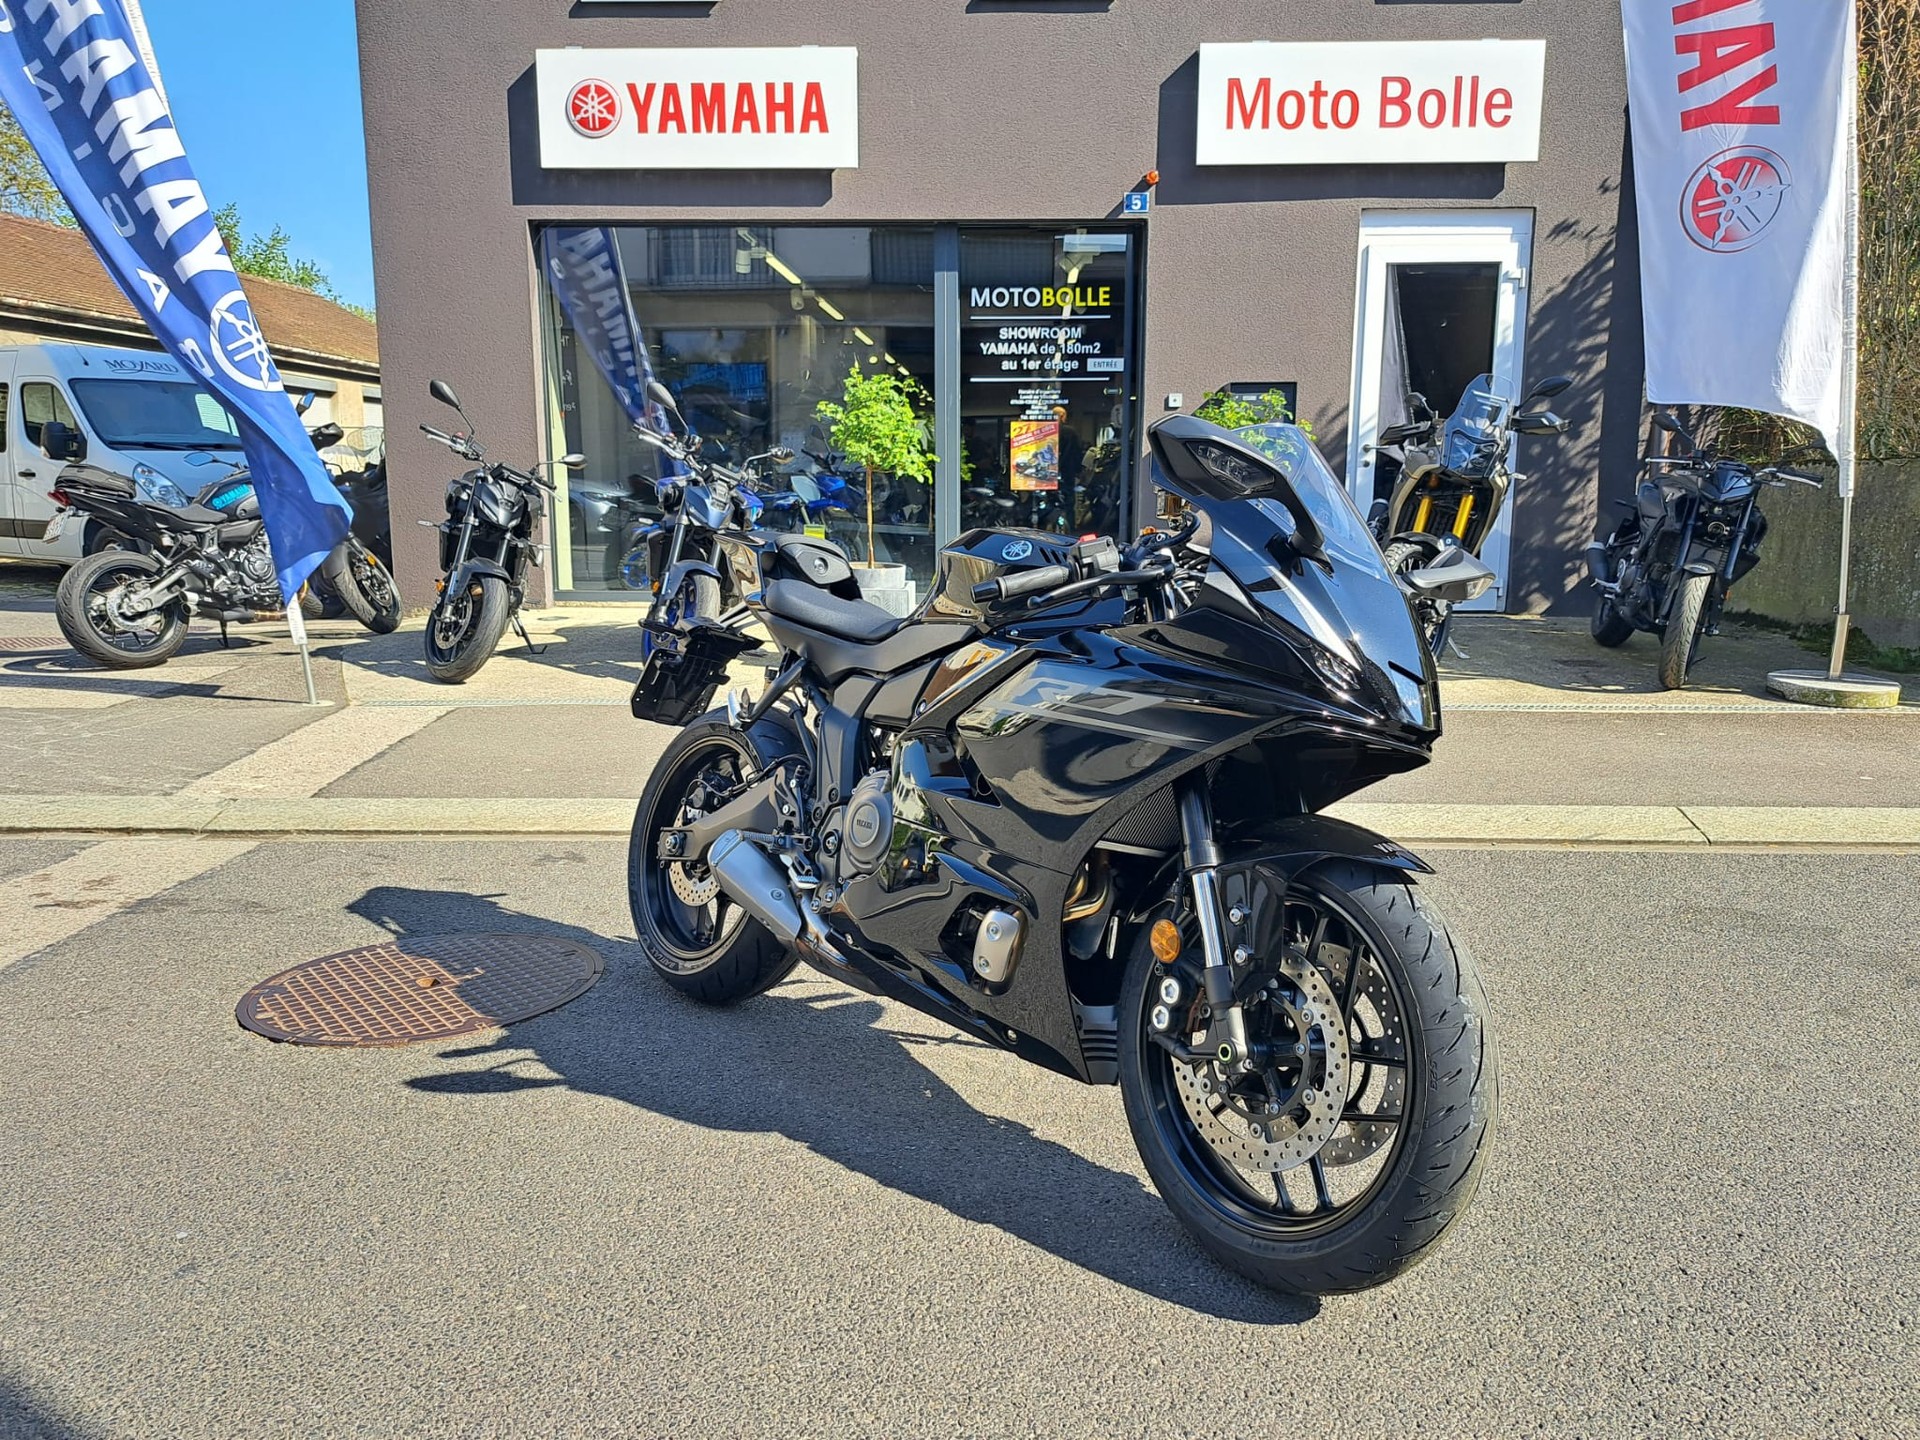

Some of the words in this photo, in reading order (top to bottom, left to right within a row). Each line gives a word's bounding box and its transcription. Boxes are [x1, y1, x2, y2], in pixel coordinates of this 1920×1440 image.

[626, 82, 829, 133] YAMAHA
[1225, 77, 1360, 130] Moto
[1378, 75, 1513, 129] Bolle
[1131, 194, 1142, 210] 5
[970, 286, 1111, 307] MOTOBOLLE
[999, 327, 1082, 340] SHOWROOM
[980, 342, 1038, 355] YAMAHA
[1040, 342, 1055, 354] de
[1060, 342, 1101, 354] 180m2
[1001, 360, 1018, 370] au
[1021, 357, 1041, 370] 1er
[1044, 358, 1079, 372] étage
